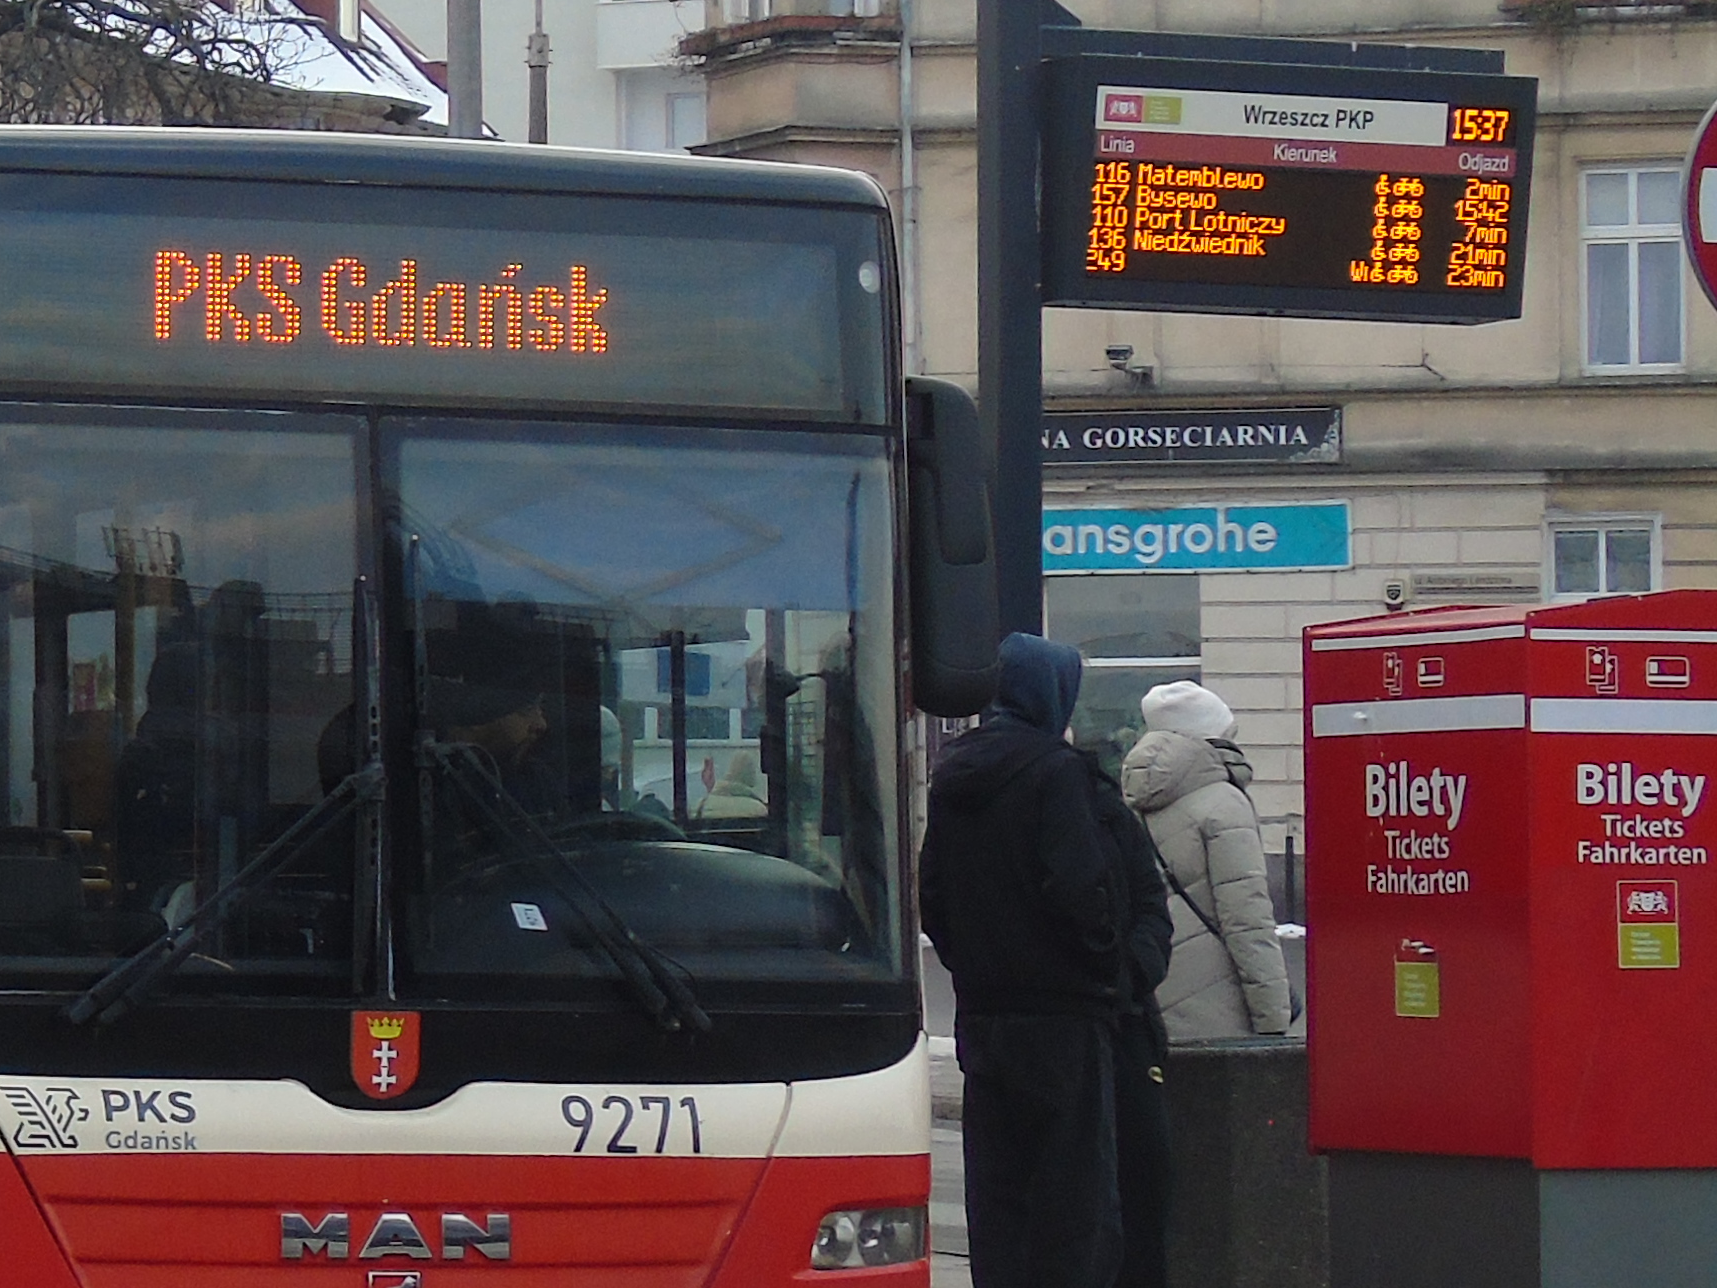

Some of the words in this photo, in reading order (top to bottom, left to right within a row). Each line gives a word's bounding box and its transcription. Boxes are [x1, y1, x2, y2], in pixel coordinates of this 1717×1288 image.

[1244, 104, 1328, 129] Wrzeszcz
[1335, 108, 1374, 129] PKP
[1452, 108, 1509, 142] 15:37
[1100, 135, 1135, 154] Linia
[1273, 143, 1337, 164] Kierunek
[1458, 152, 1509, 174] Odjazd
[1094, 162, 1131, 183] 116
[1137, 162, 1265, 190] Matemblewo
[1465, 178, 1511, 200] 2min
[1091, 183, 1130, 205] 157
[1136, 184, 1217, 209] Bysewo
[1454, 200, 1509, 222] 15:42
[1092, 205, 1128, 227] 110
[1135, 207, 1184, 230] Port
[1190, 209, 1286, 234] Lotniczy
[1464, 222, 1508, 244] 7min
[1088, 227, 1126, 250] 136
[1134, 229, 1266, 255] Niedźwiednik
[1451, 242, 1506, 265] 21min
[1446, 264, 1505, 287] 23min
[154, 249, 302, 343] PKS
[321, 256, 609, 353] Gdańsk
[1082, 424, 1309, 449] GORSECIARNIA
[1044, 512, 1278, 563] ansgrohe
[1365, 761, 1467, 831] Bilety
[1576, 762, 1706, 817] Bilety
[1384, 829, 1450, 860] Tickets
[1601, 814, 1684, 838] Tickets
[1577, 841, 1707, 864] Fahrkarten
[1367, 865, 1469, 895] Fahrkarten
[101, 1088, 197, 1124] PKS
[561, 1095, 701, 1154] 9271
[105, 1130, 197, 1150] Gdańsk
[281, 1213, 510, 1259] MAN
